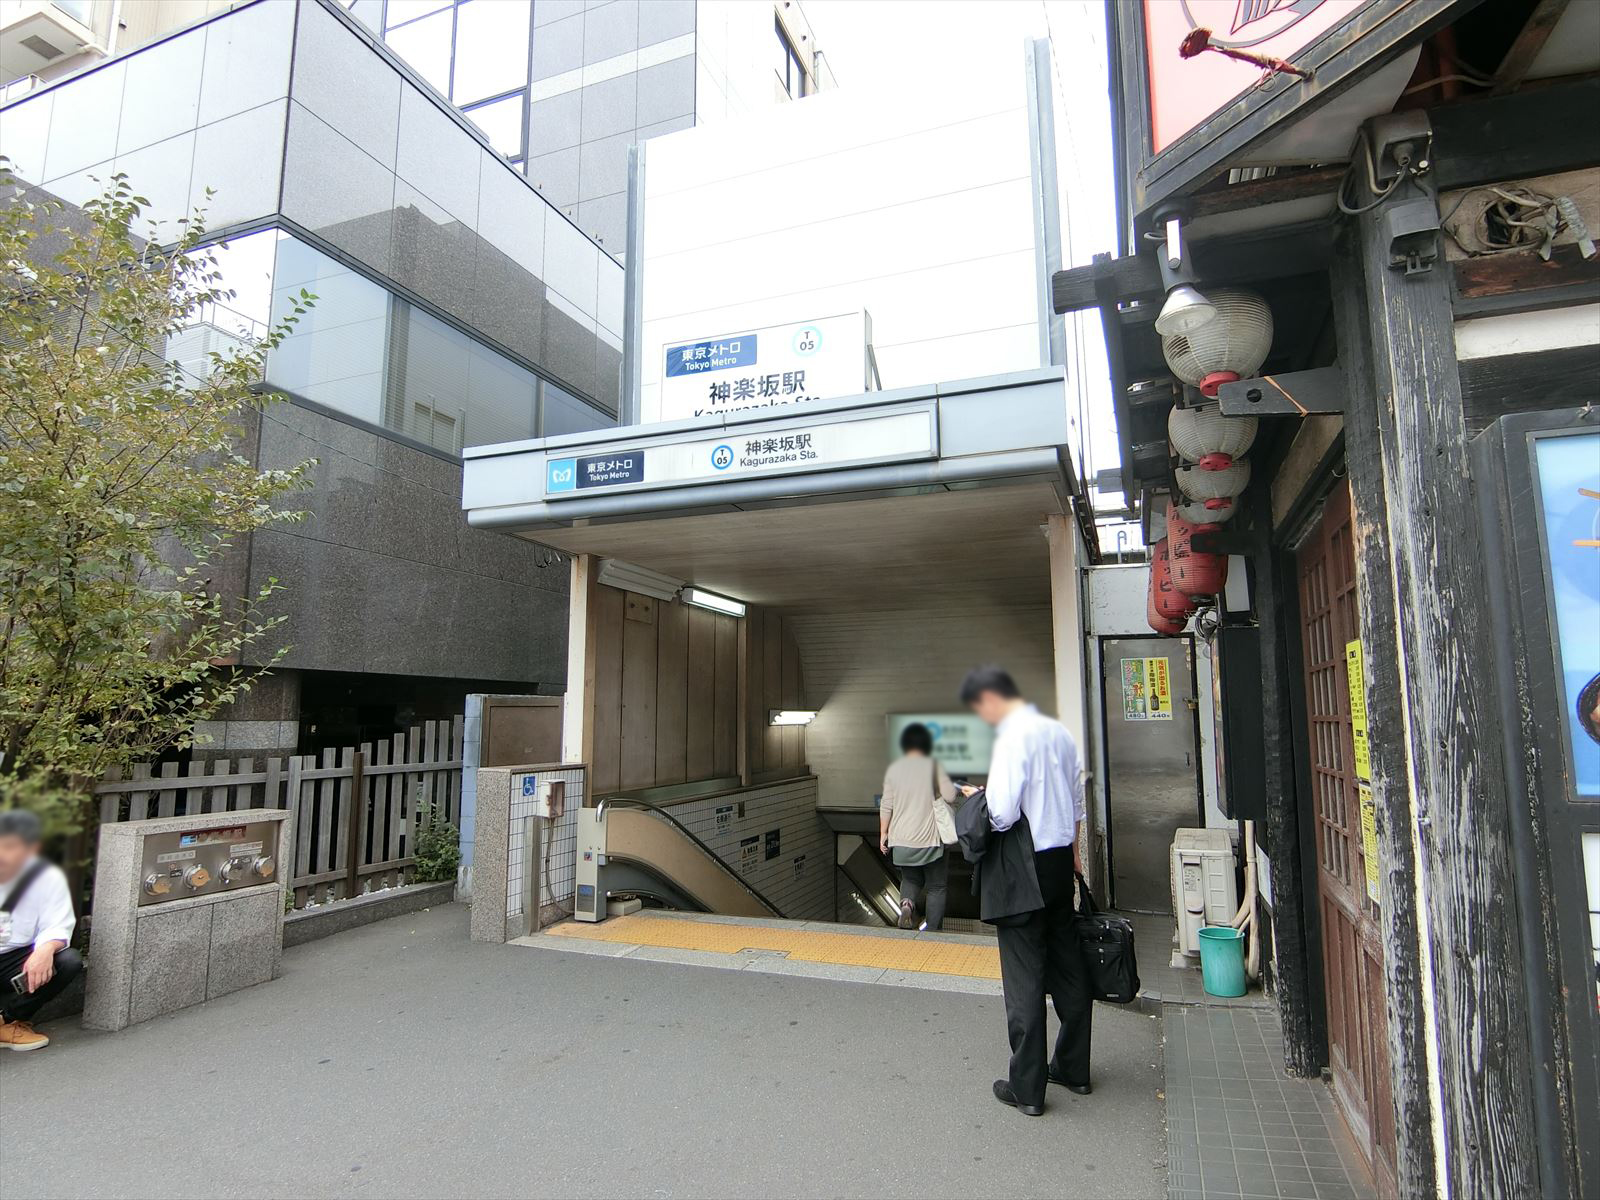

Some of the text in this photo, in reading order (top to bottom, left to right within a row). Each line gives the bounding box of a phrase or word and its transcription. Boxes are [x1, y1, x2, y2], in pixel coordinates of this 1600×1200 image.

[682, 341, 741, 362] 東京メトロ
[799, 340, 815, 351] 05
[685, 356, 737, 371] Tokyo Metro
[709, 369, 806, 405] 神楽坂駅
[745, 433, 812, 456] 神楽坂駅
[586, 459, 633, 474] 東京メトロ
[716, 456, 728, 465] 05
[740, 450, 819, 468] Kagurazaka Sta.
[589, 471, 630, 482] Tokyo Metro
